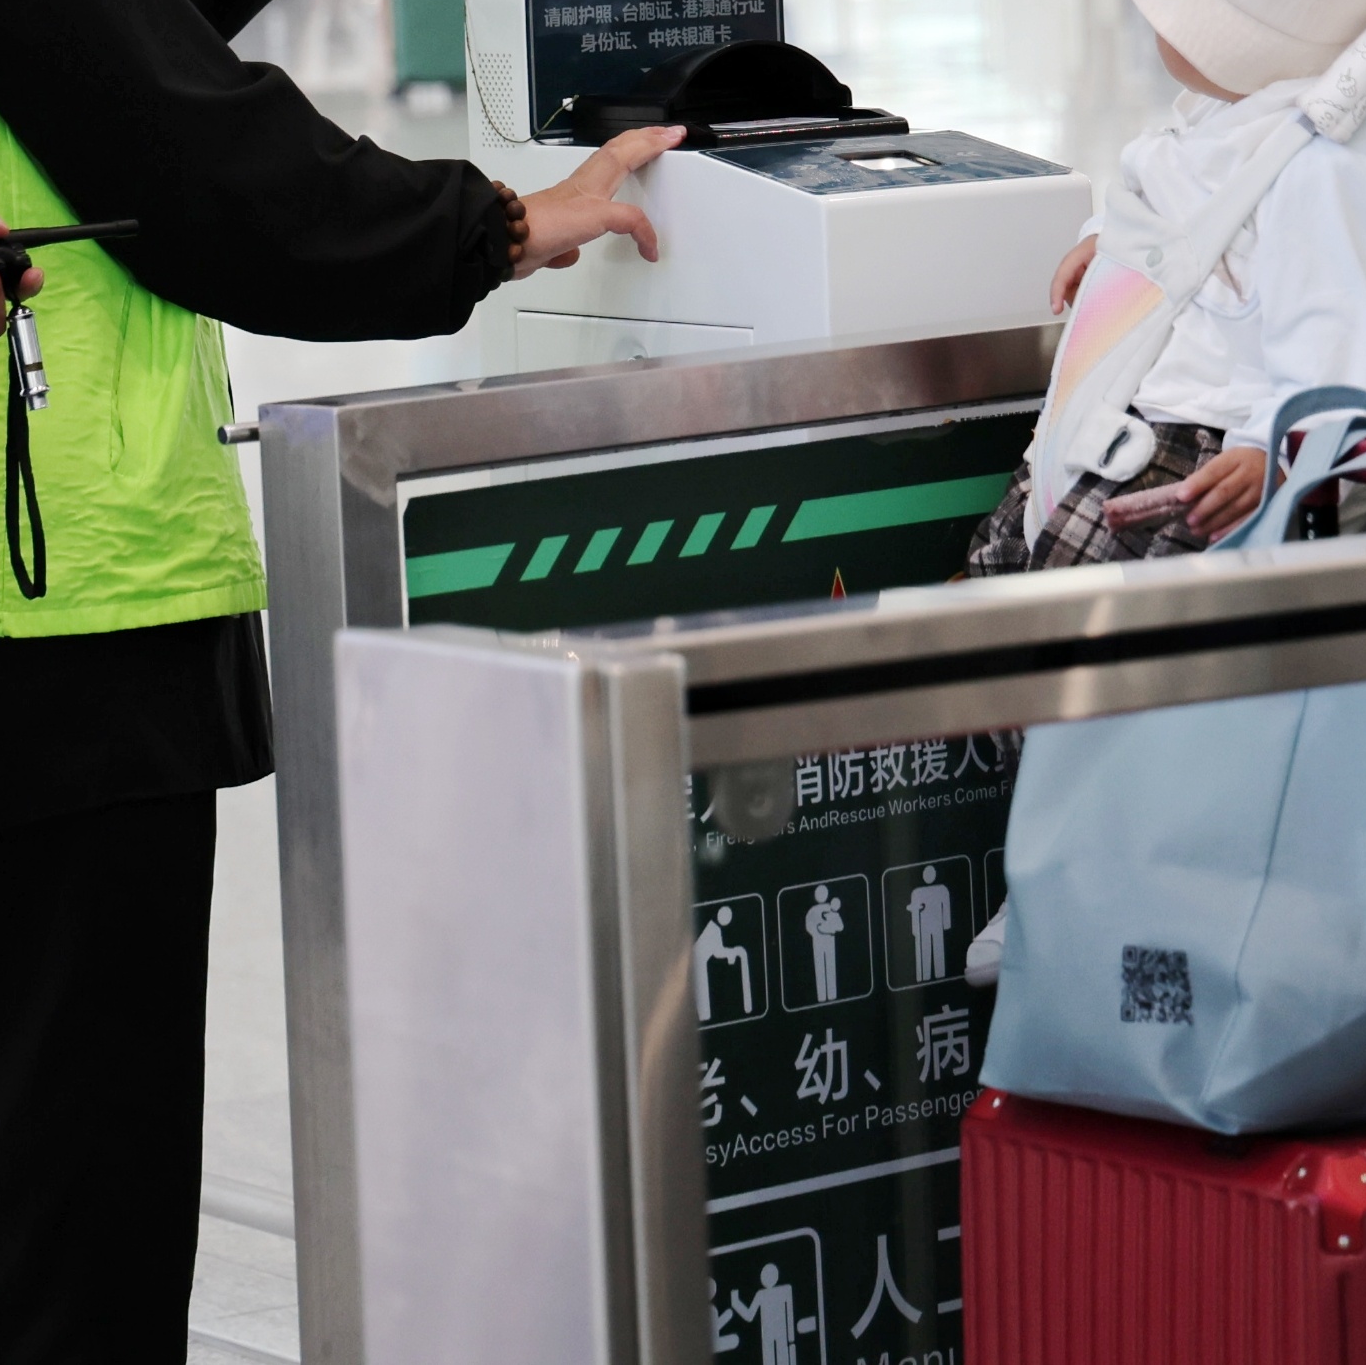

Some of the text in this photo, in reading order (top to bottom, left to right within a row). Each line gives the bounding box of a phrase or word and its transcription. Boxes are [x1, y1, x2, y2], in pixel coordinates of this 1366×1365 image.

[798, 806, 886, 833] AndRescue
[887, 793, 952, 817] Workers
[954, 785, 997, 804] Come
[822, 1113, 860, 1140] For
